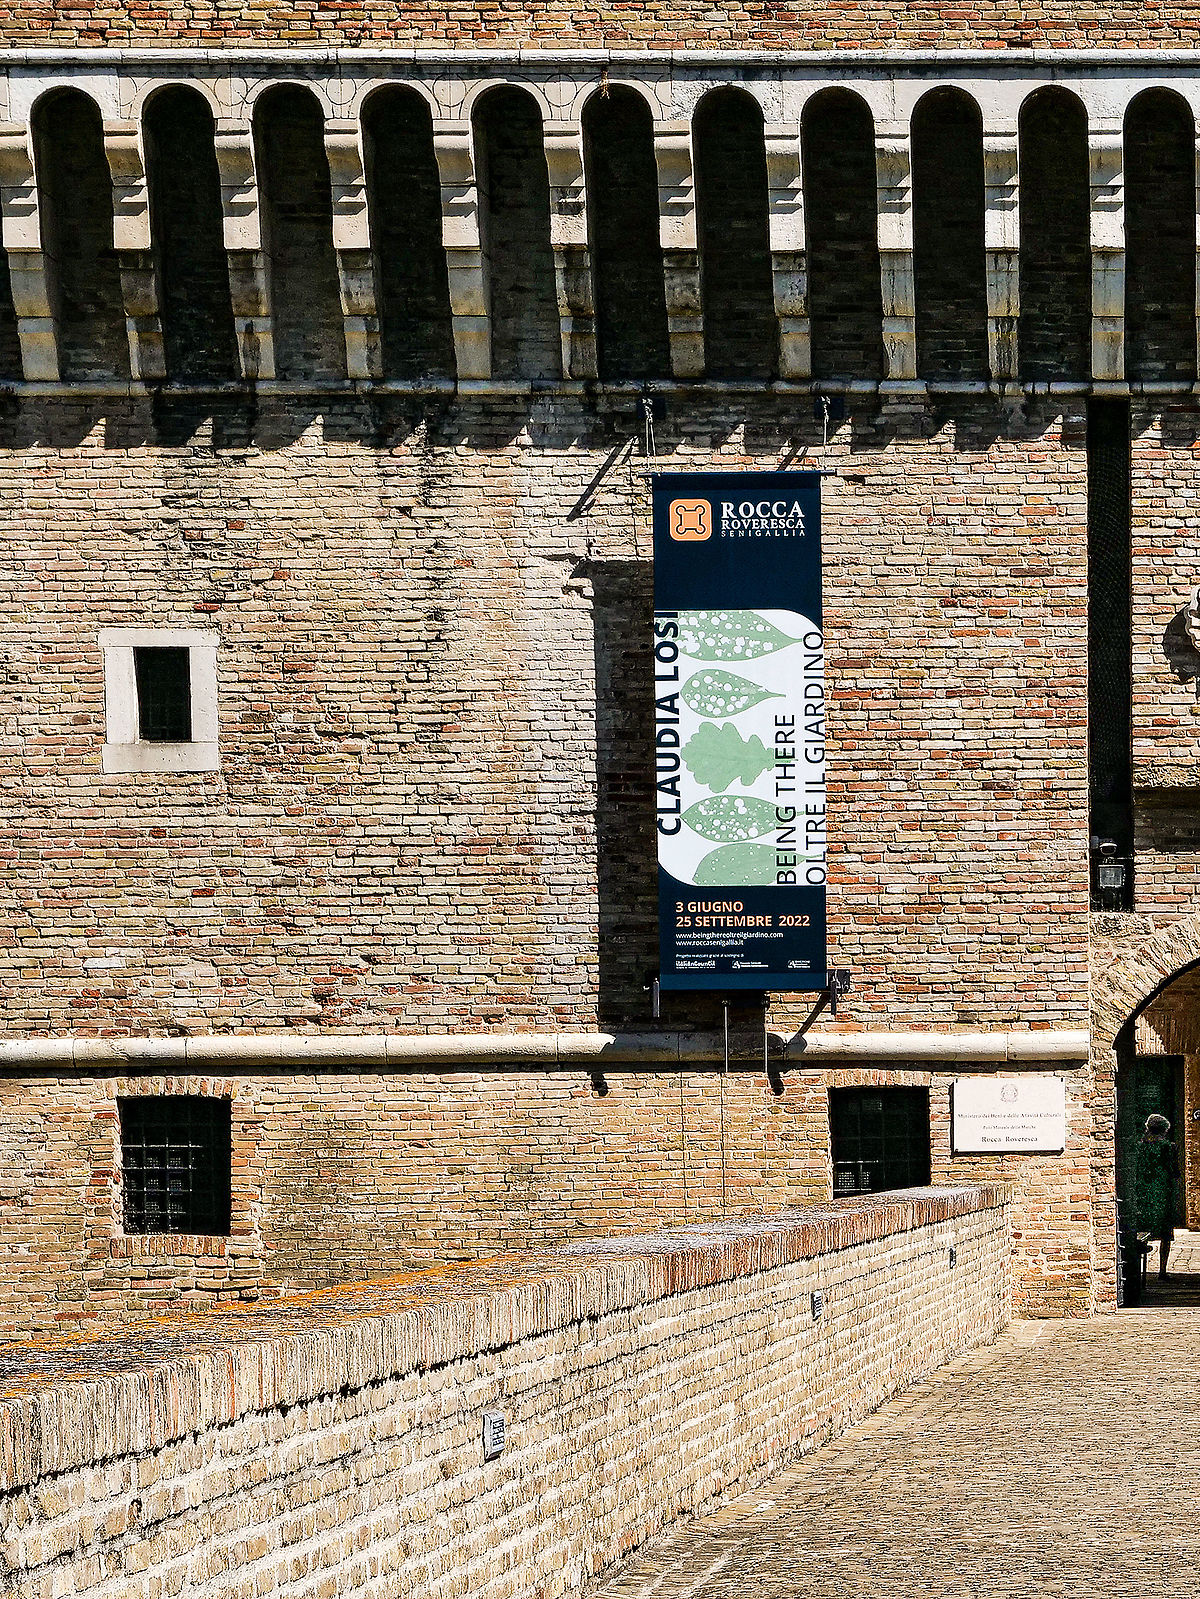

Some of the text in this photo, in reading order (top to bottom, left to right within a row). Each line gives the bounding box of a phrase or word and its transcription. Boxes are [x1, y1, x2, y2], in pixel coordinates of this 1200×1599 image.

[721, 501, 805, 518] ROCCA
[721, 519, 805, 529] ROVERESCA
[721, 529, 805, 537] SENIGALLIA
[653, 611, 681, 835] CLAUDIA LOSI
[803, 631, 827, 885] OLTRE IL GIARDINO
[774, 715, 797, 884] BEING THERE
[675, 901, 744, 913] 3 GIUGNO
[675, 915, 811, 927] 25 SETTEMBRE 2022
[675, 939, 744, 947] www.roccasenigallia.it
